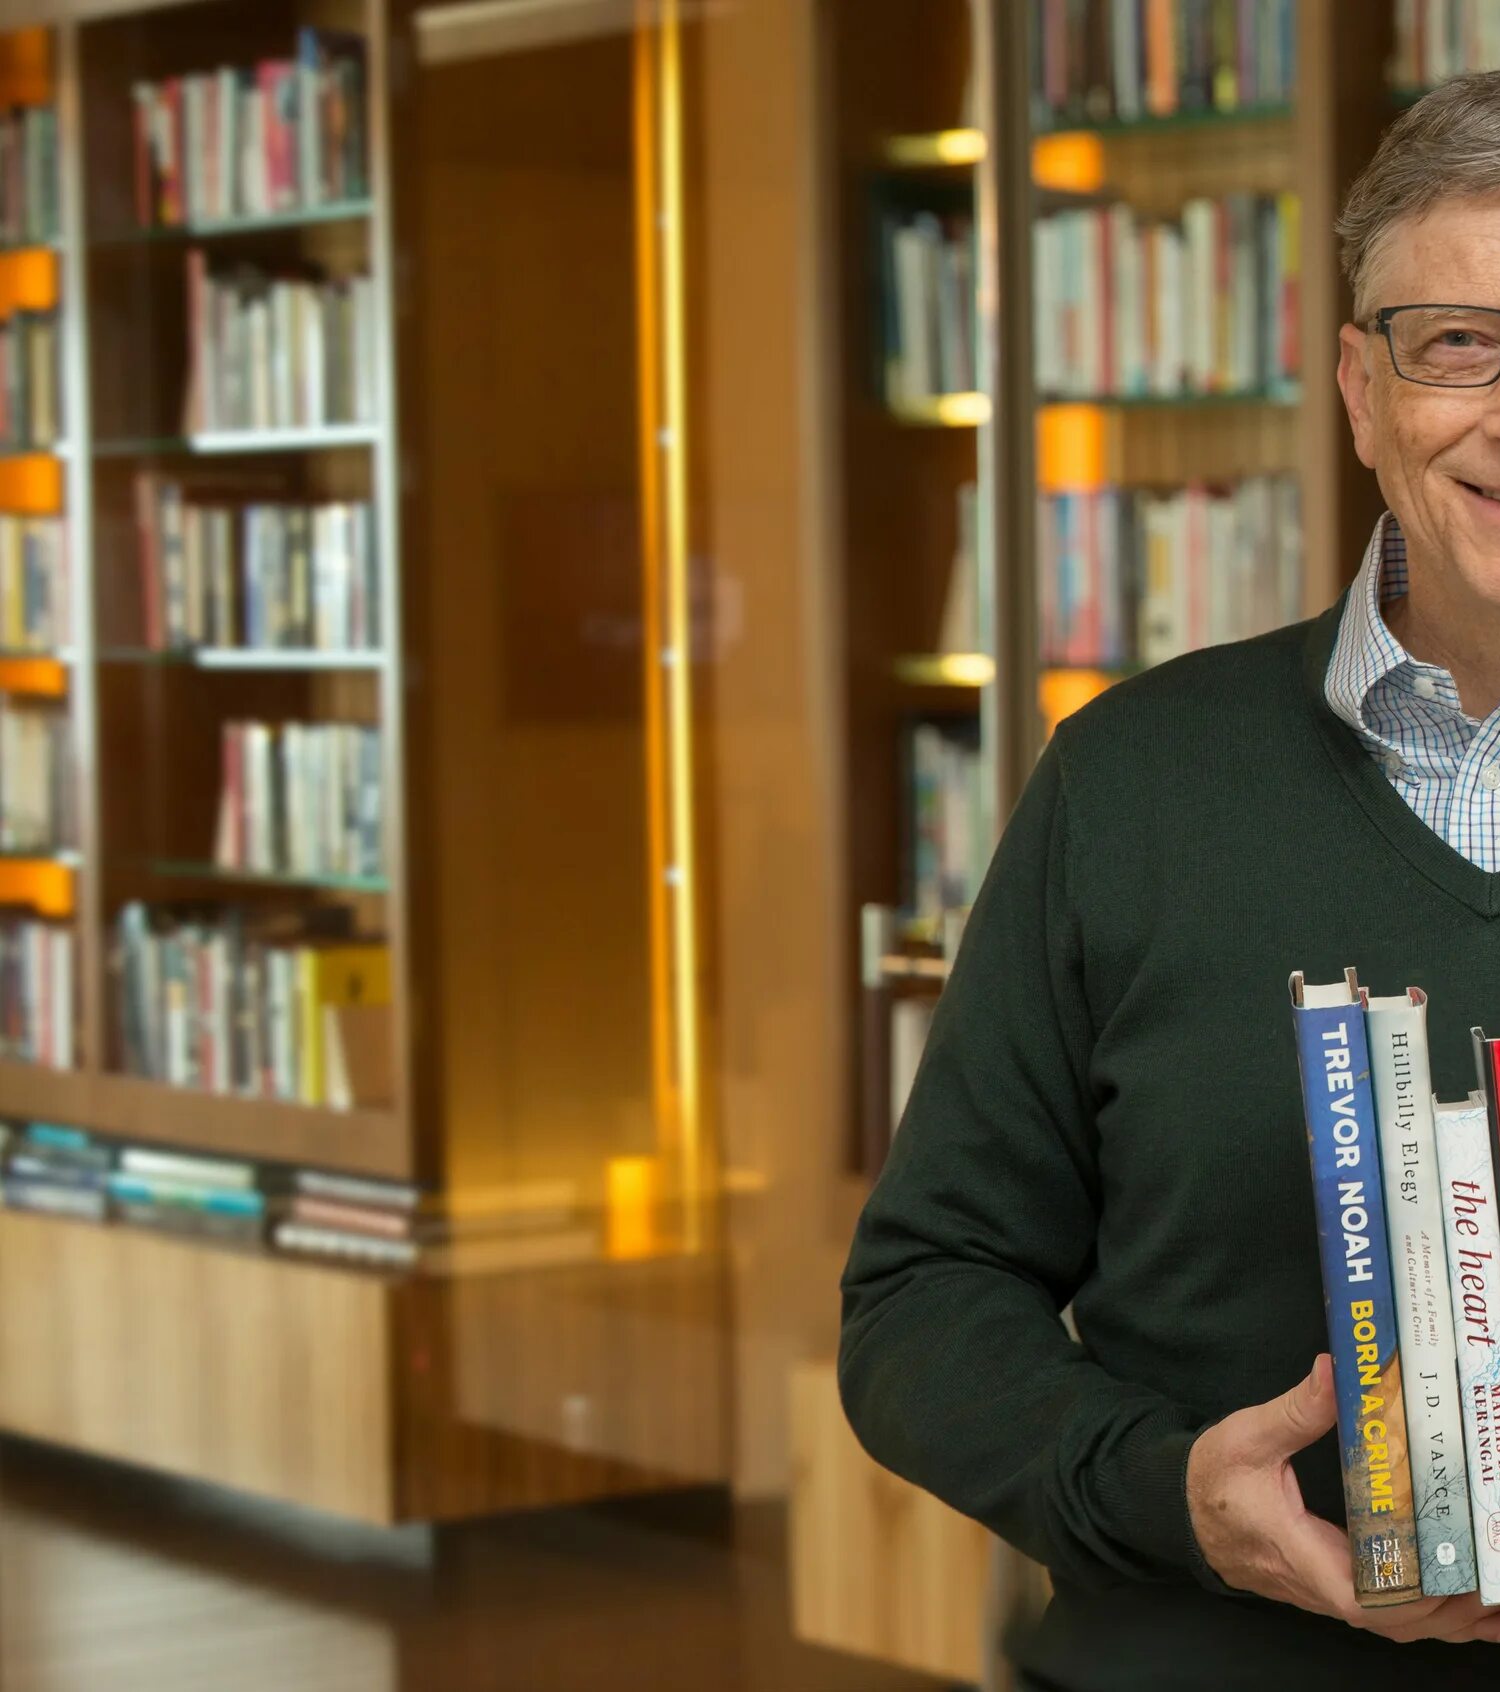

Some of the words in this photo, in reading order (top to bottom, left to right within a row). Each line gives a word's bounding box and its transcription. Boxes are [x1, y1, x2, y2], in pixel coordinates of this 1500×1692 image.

[1322, 1022, 1361, 1168] TREVOR
[1392, 1032, 1415, 1131] Hillbilly
[1400, 1141, 1419, 1205] Elegy
[1451, 1180, 1488, 1236] the
[1338, 1181, 1373, 1283] NOAH
[1405, 1234, 1416, 1254] and
[1421, 1230, 1430, 1240] A
[1407, 1257, 1418, 1299] Culture
[1421, 1244, 1433, 1285] Memoir
[1411, 1302, 1421, 1313] in
[1424, 1287, 1437, 1299] of
[1458, 1249, 1496, 1348] heart
[1350, 1299, 1382, 1386] BORN
[1412, 1316, 1424, 1346] Crisis
[1428, 1310, 1440, 1346] Family
[1361, 1394, 1385, 1415] A
[1420, 1372, 1440, 1418] J.D.
[1430, 1431, 1450, 1521] VANCE
[1473, 1384, 1495, 1486] KERANGAL
[1363, 1419, 1395, 1514] CRIME
[1371, 1538, 1400, 1553] SPI
[1373, 1550, 1403, 1566] EGE
[1375, 1574, 1404, 1589] RAU
